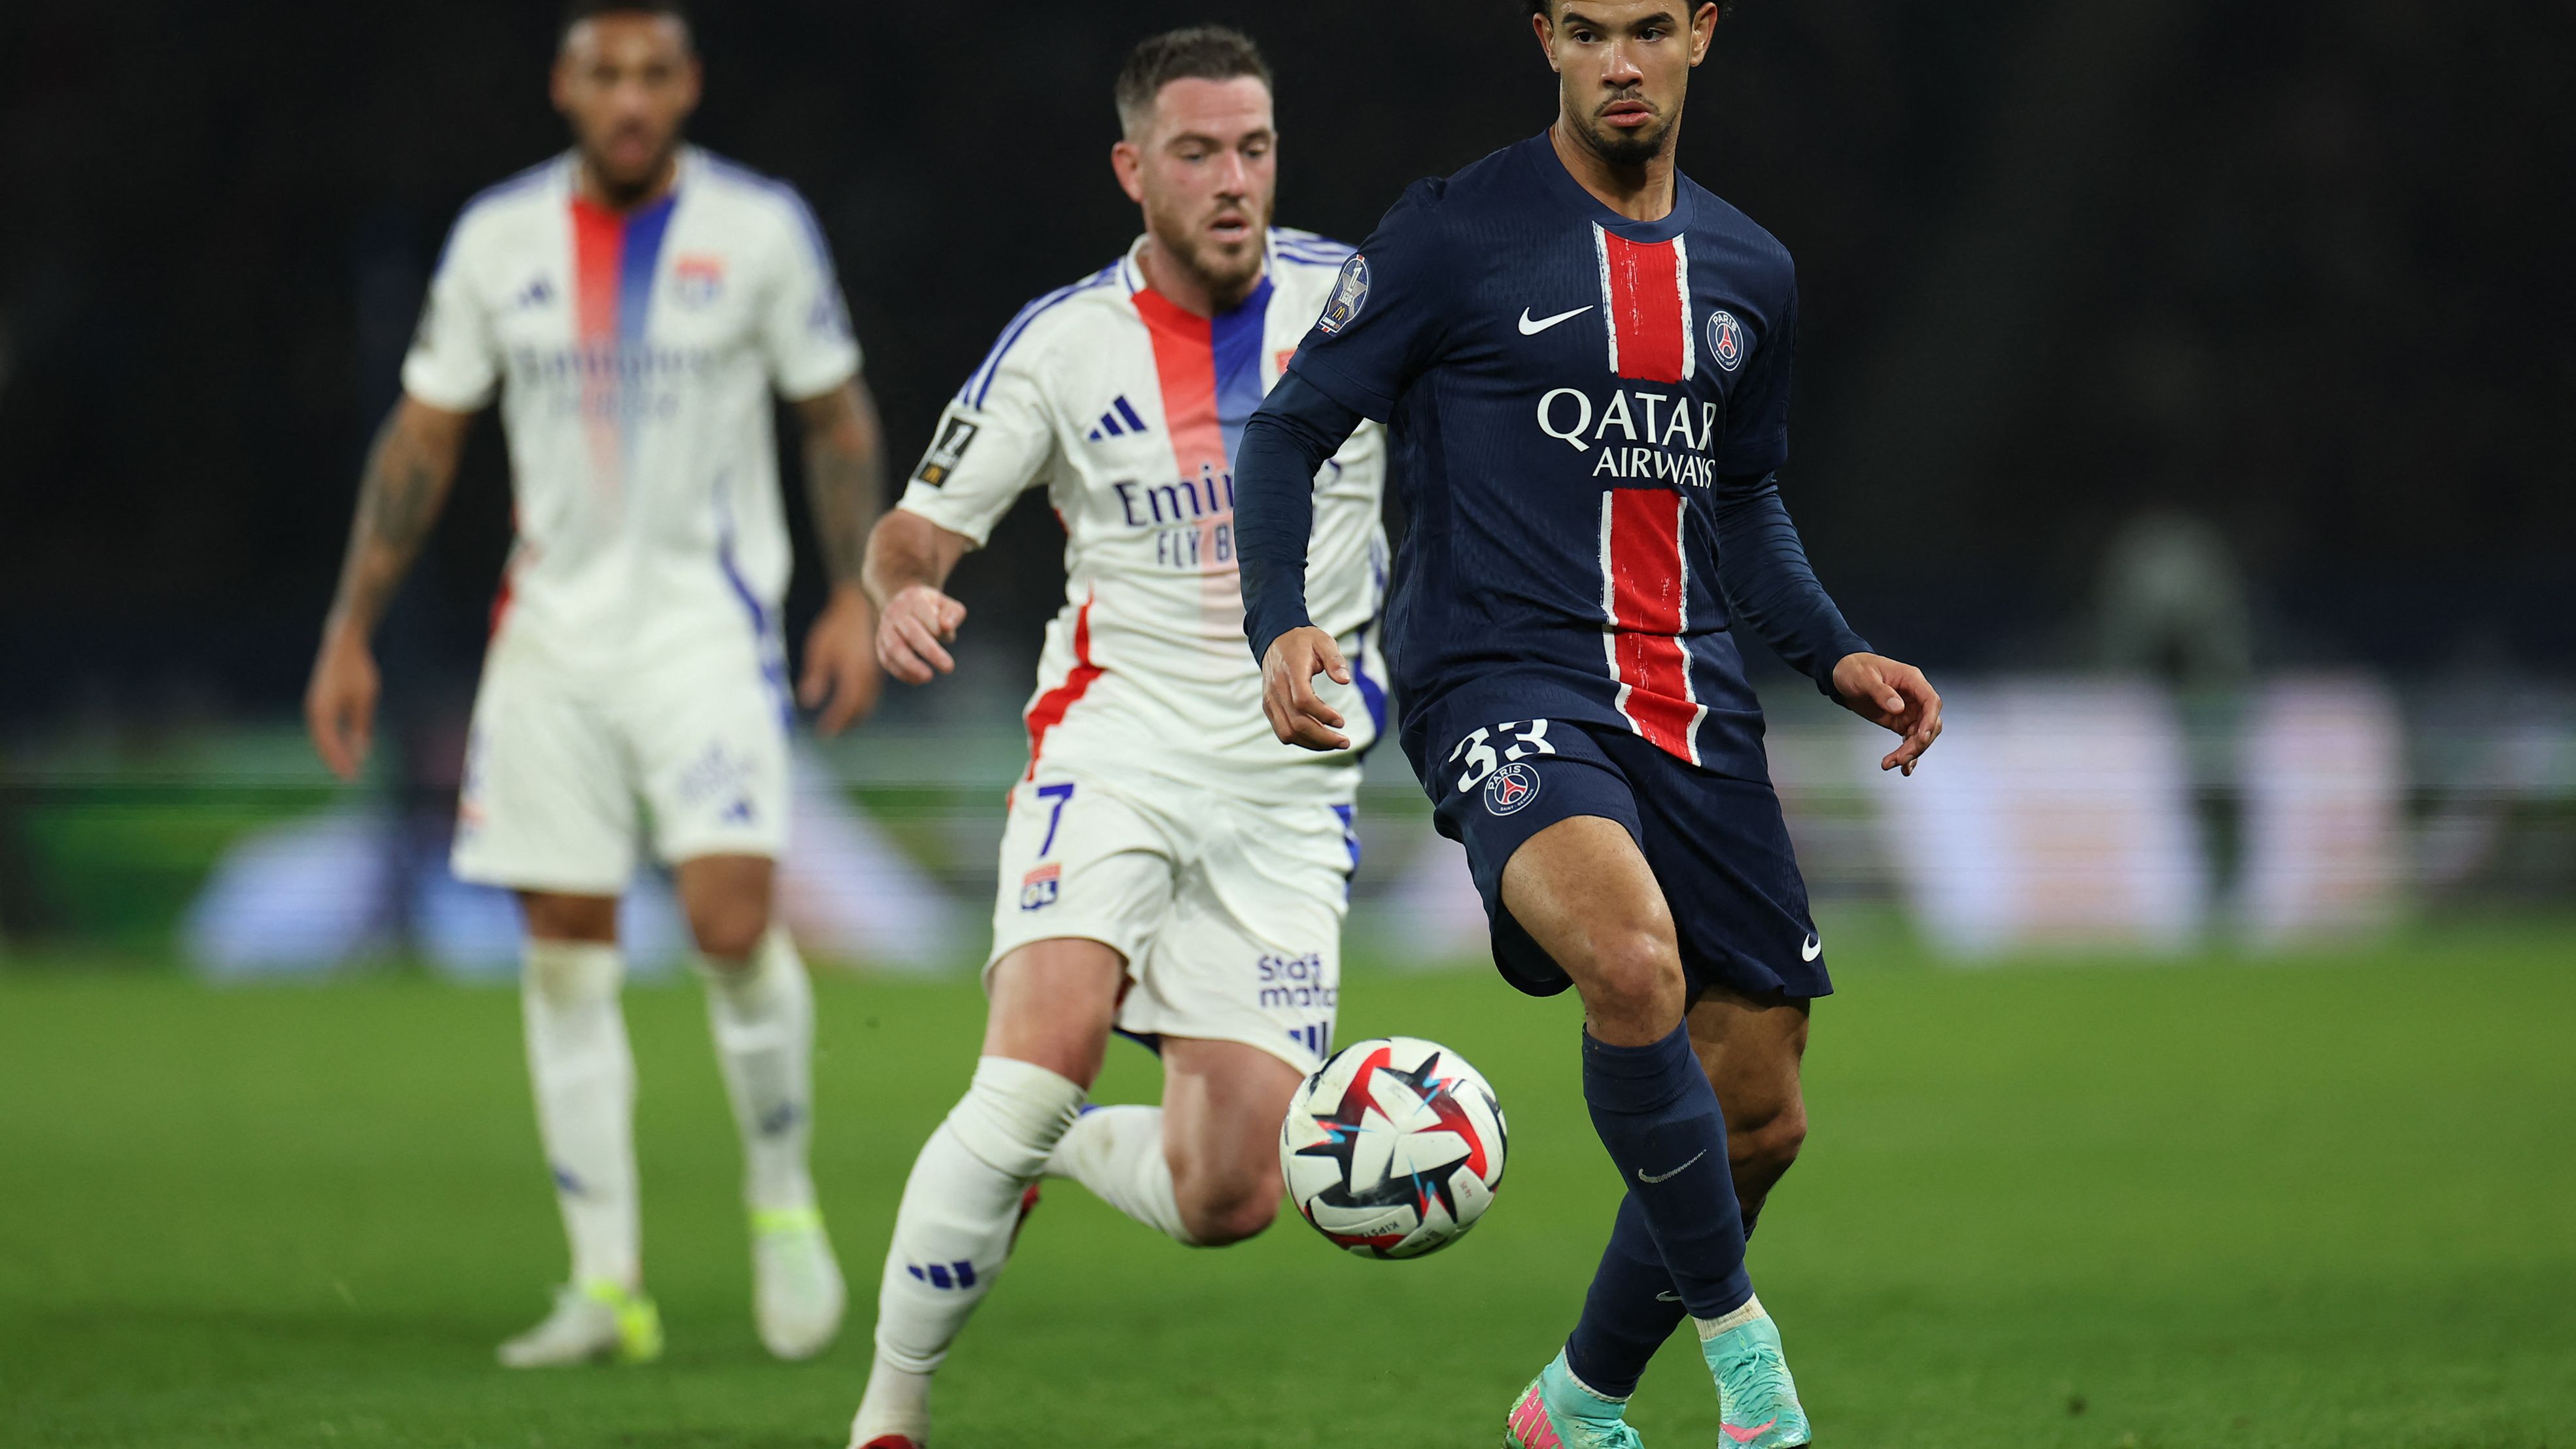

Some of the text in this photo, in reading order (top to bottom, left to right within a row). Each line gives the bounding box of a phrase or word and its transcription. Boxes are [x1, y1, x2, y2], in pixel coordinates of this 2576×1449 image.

[1712, 314, 1737, 332] PARIS
[1537, 388, 1717, 452] QATAR
[1592, 446, 1715, 489] AIRWAYS
[1112, 465, 1234, 526] Emir
[1157, 530, 1201, 568] FLY
[1448, 718, 1556, 793] 33
[1487, 765, 1522, 791] PARIS
[1517, 788, 1534, 807] GERMAIN
[1038, 783, 1074, 859] 7
[1023, 880, 1056, 908] OL
[1260, 983, 1339, 1008] matc
